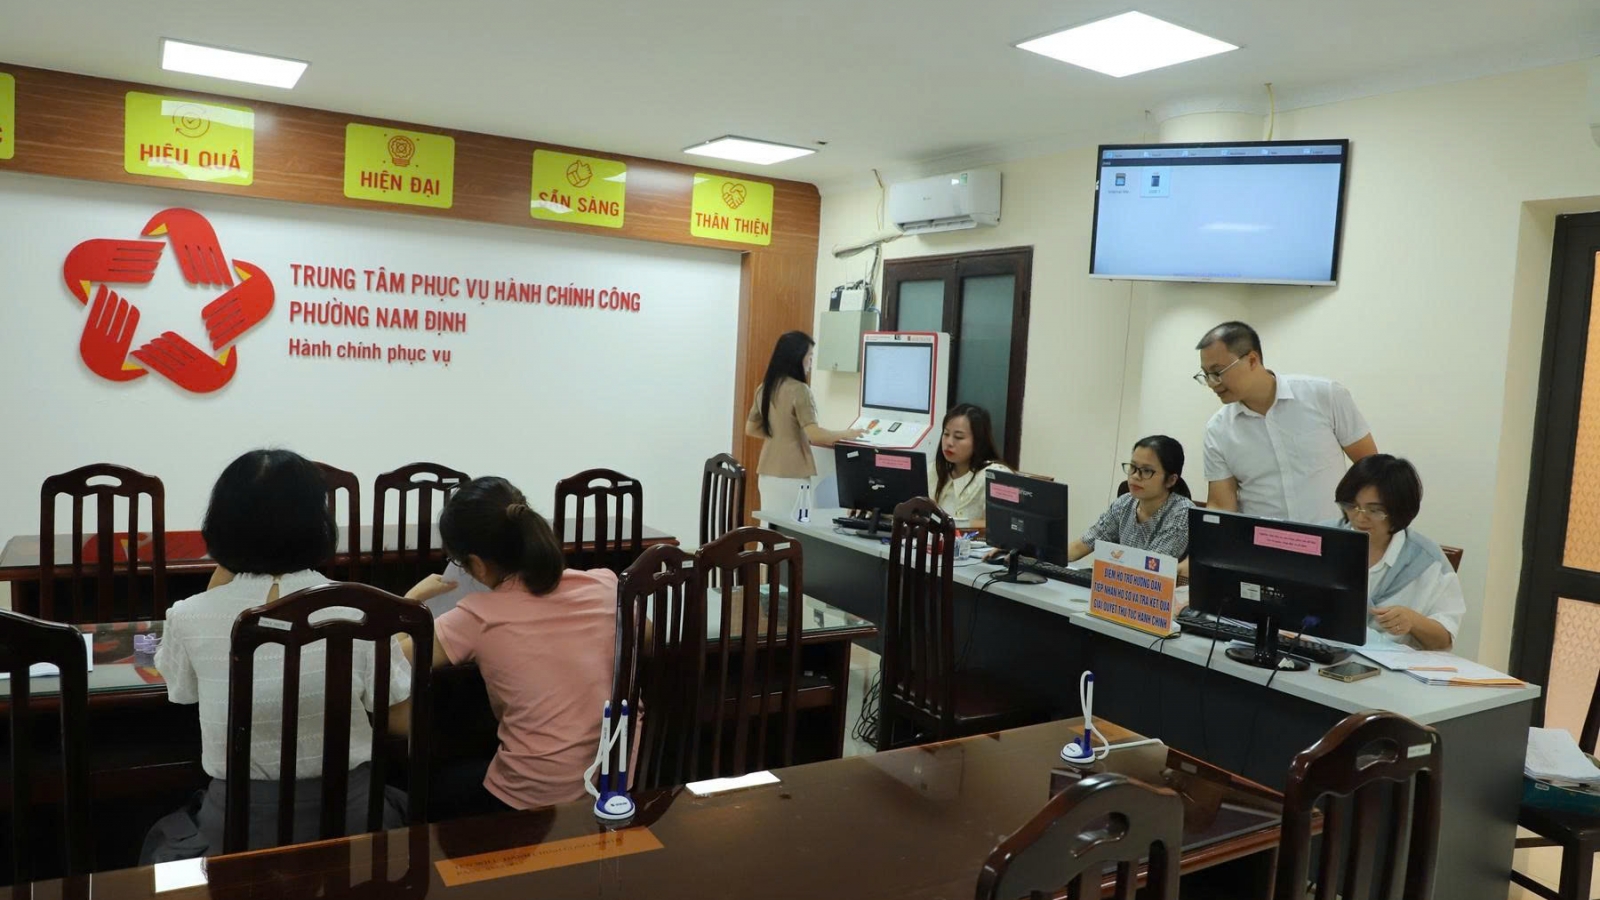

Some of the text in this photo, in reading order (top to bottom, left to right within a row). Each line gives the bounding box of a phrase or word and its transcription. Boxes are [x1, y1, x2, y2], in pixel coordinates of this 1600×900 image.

[198, 149, 241, 172] QUẢ
[360, 170, 440, 197] HIỆN ĐẠI
[577, 195, 620, 217] SÀNG
[695, 212, 769, 238] THÂN THIỆN
[289, 263, 641, 313] TRUNG TÂM PHỤC VỤ HÀNH CHÍNH CÔNG
[289, 297, 466, 336] PHƯỜNG NAM ĐỊNH
[288, 337, 451, 367] Hành chính phục vụ
